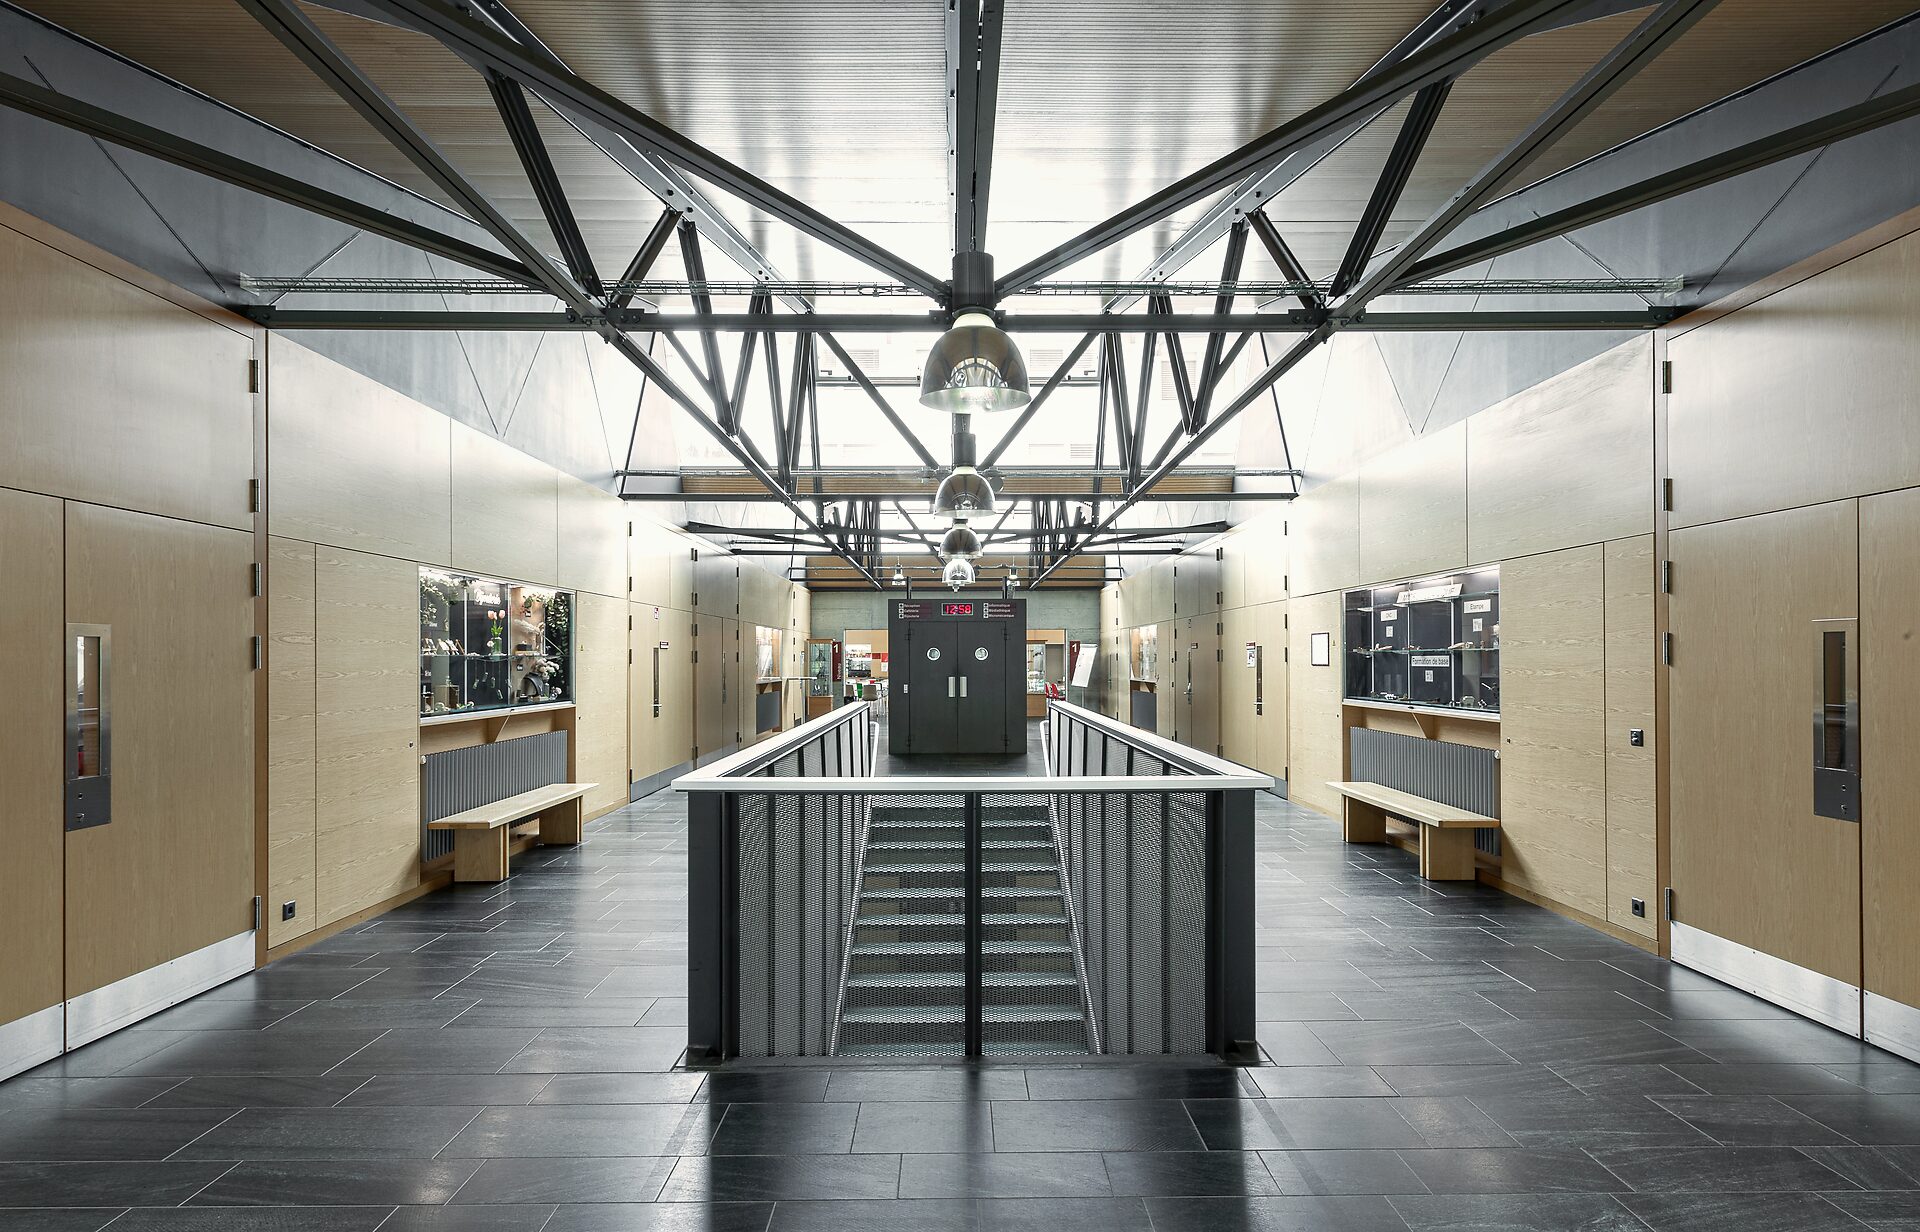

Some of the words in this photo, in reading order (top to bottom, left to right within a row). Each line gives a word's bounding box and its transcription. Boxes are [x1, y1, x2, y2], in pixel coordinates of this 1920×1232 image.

[945, 604, 971, 614] 12:58
[833, 643, 839, 654] 1
[1071, 643, 1077, 653] 1
[1412, 656, 1431, 665] Formation
[1432, 656, 1438, 665] de
[1438, 656, 1449, 665] base
